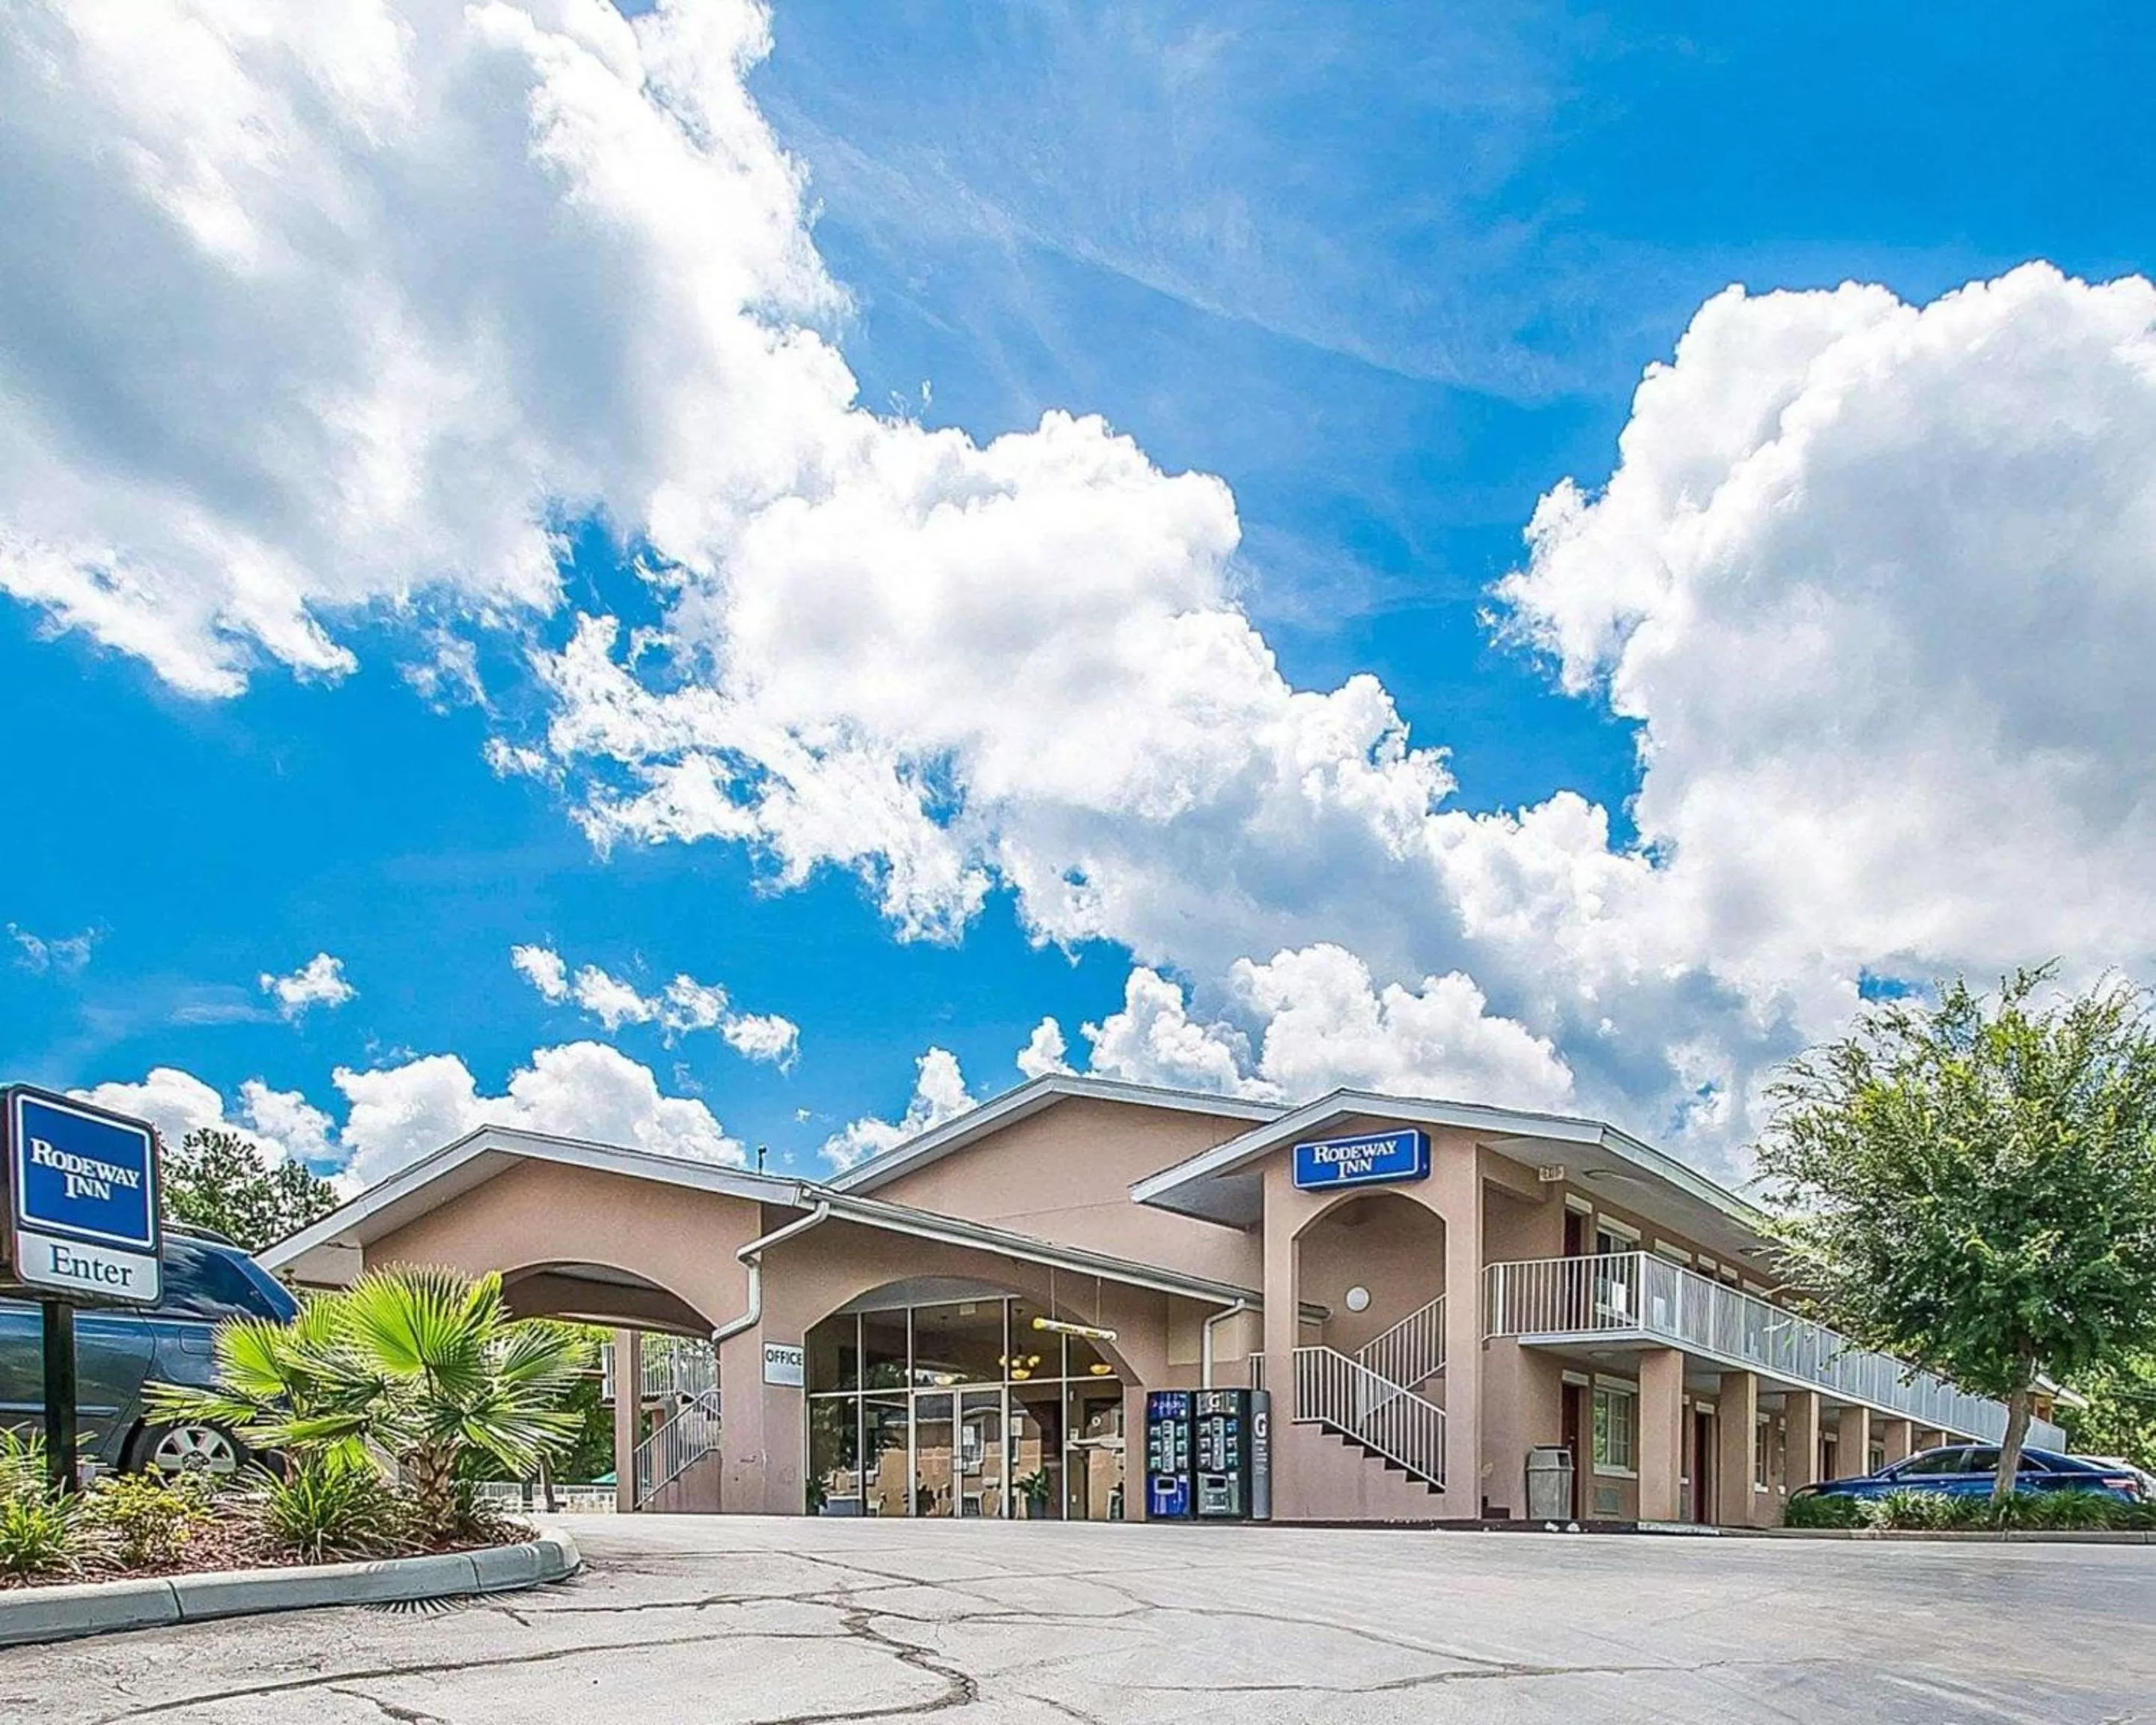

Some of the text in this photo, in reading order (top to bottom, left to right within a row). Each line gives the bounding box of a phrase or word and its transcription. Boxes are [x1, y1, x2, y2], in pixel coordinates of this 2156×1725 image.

[30, 1137, 140, 1189] RODEWAY
[1313, 1140, 1398, 1164] RODEWAY
[1338, 1158, 1372, 1178] INN
[64, 1172, 111, 1201] INN
[49, 1244, 133, 1286] Enter
[766, 1349, 803, 1366] OFFICE
